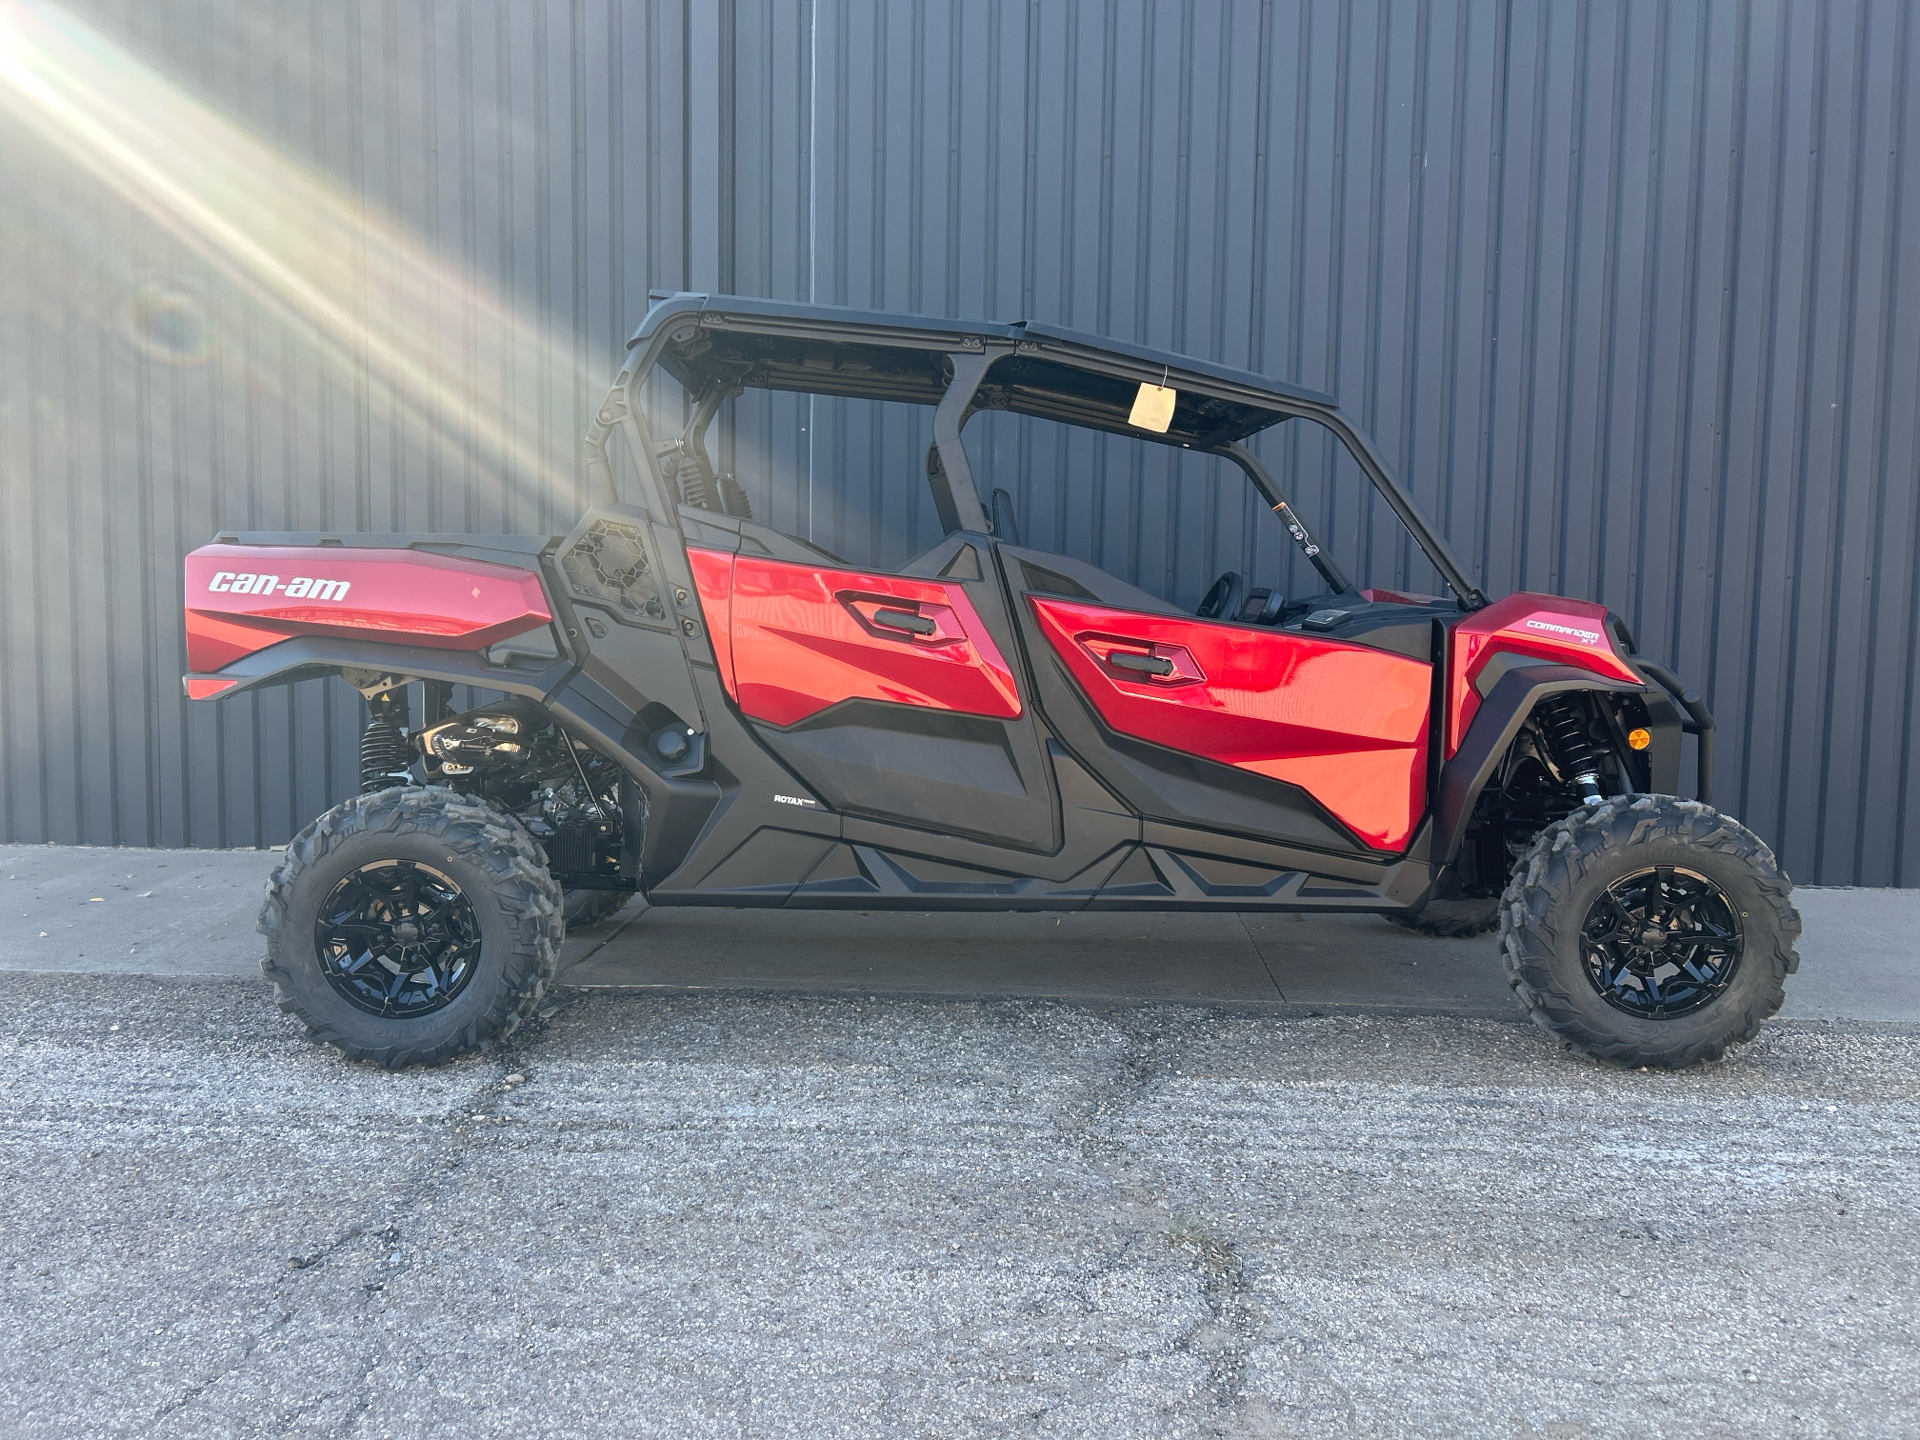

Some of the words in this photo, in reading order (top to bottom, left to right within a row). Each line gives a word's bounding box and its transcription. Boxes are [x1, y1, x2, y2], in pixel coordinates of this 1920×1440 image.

[208, 571, 350, 601] can-am
[1526, 619, 1600, 640] COMMANDER
[1580, 637, 1598, 645] XT
[773, 794, 804, 806] ROTAX
